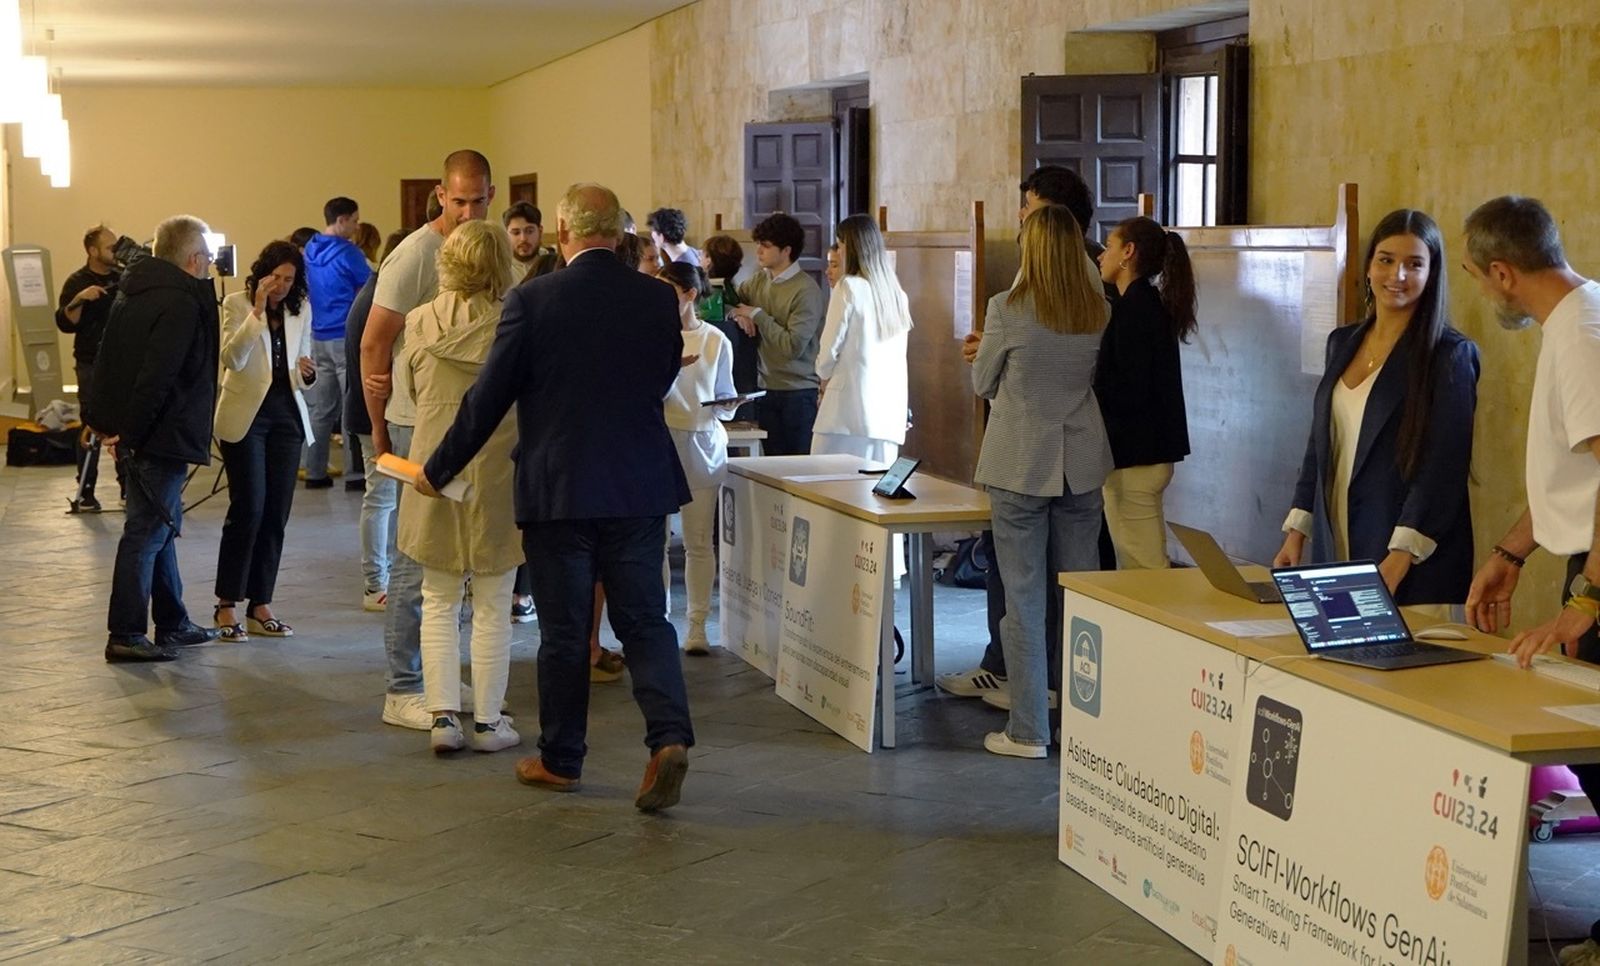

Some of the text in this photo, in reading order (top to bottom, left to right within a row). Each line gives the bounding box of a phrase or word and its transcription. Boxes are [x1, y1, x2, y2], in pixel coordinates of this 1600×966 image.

[1191, 688, 1232, 722] CUI23.24
[1066, 766, 1207, 860] Herramienta digital de ayuda al ciudadano
[1067, 736, 1220, 841] Asistente Ciudadano Digital:
[1433, 791, 1499, 840] CUI23.24
[1066, 787, 1088, 814] basada
[1098, 808, 1136, 843] inteligencia
[1137, 833, 1166, 860] artificial
[1166, 852, 1205, 886] generativa
[1229, 900, 1279, 944] Generative
[1280, 931, 1291, 952] AI
[1232, 874, 1260, 905] Smart
[1262, 889, 1301, 932] Tracking
[1302, 913, 1358, 962] Framework
[1236, 833, 1377, 939] SCIFI-Workflows
